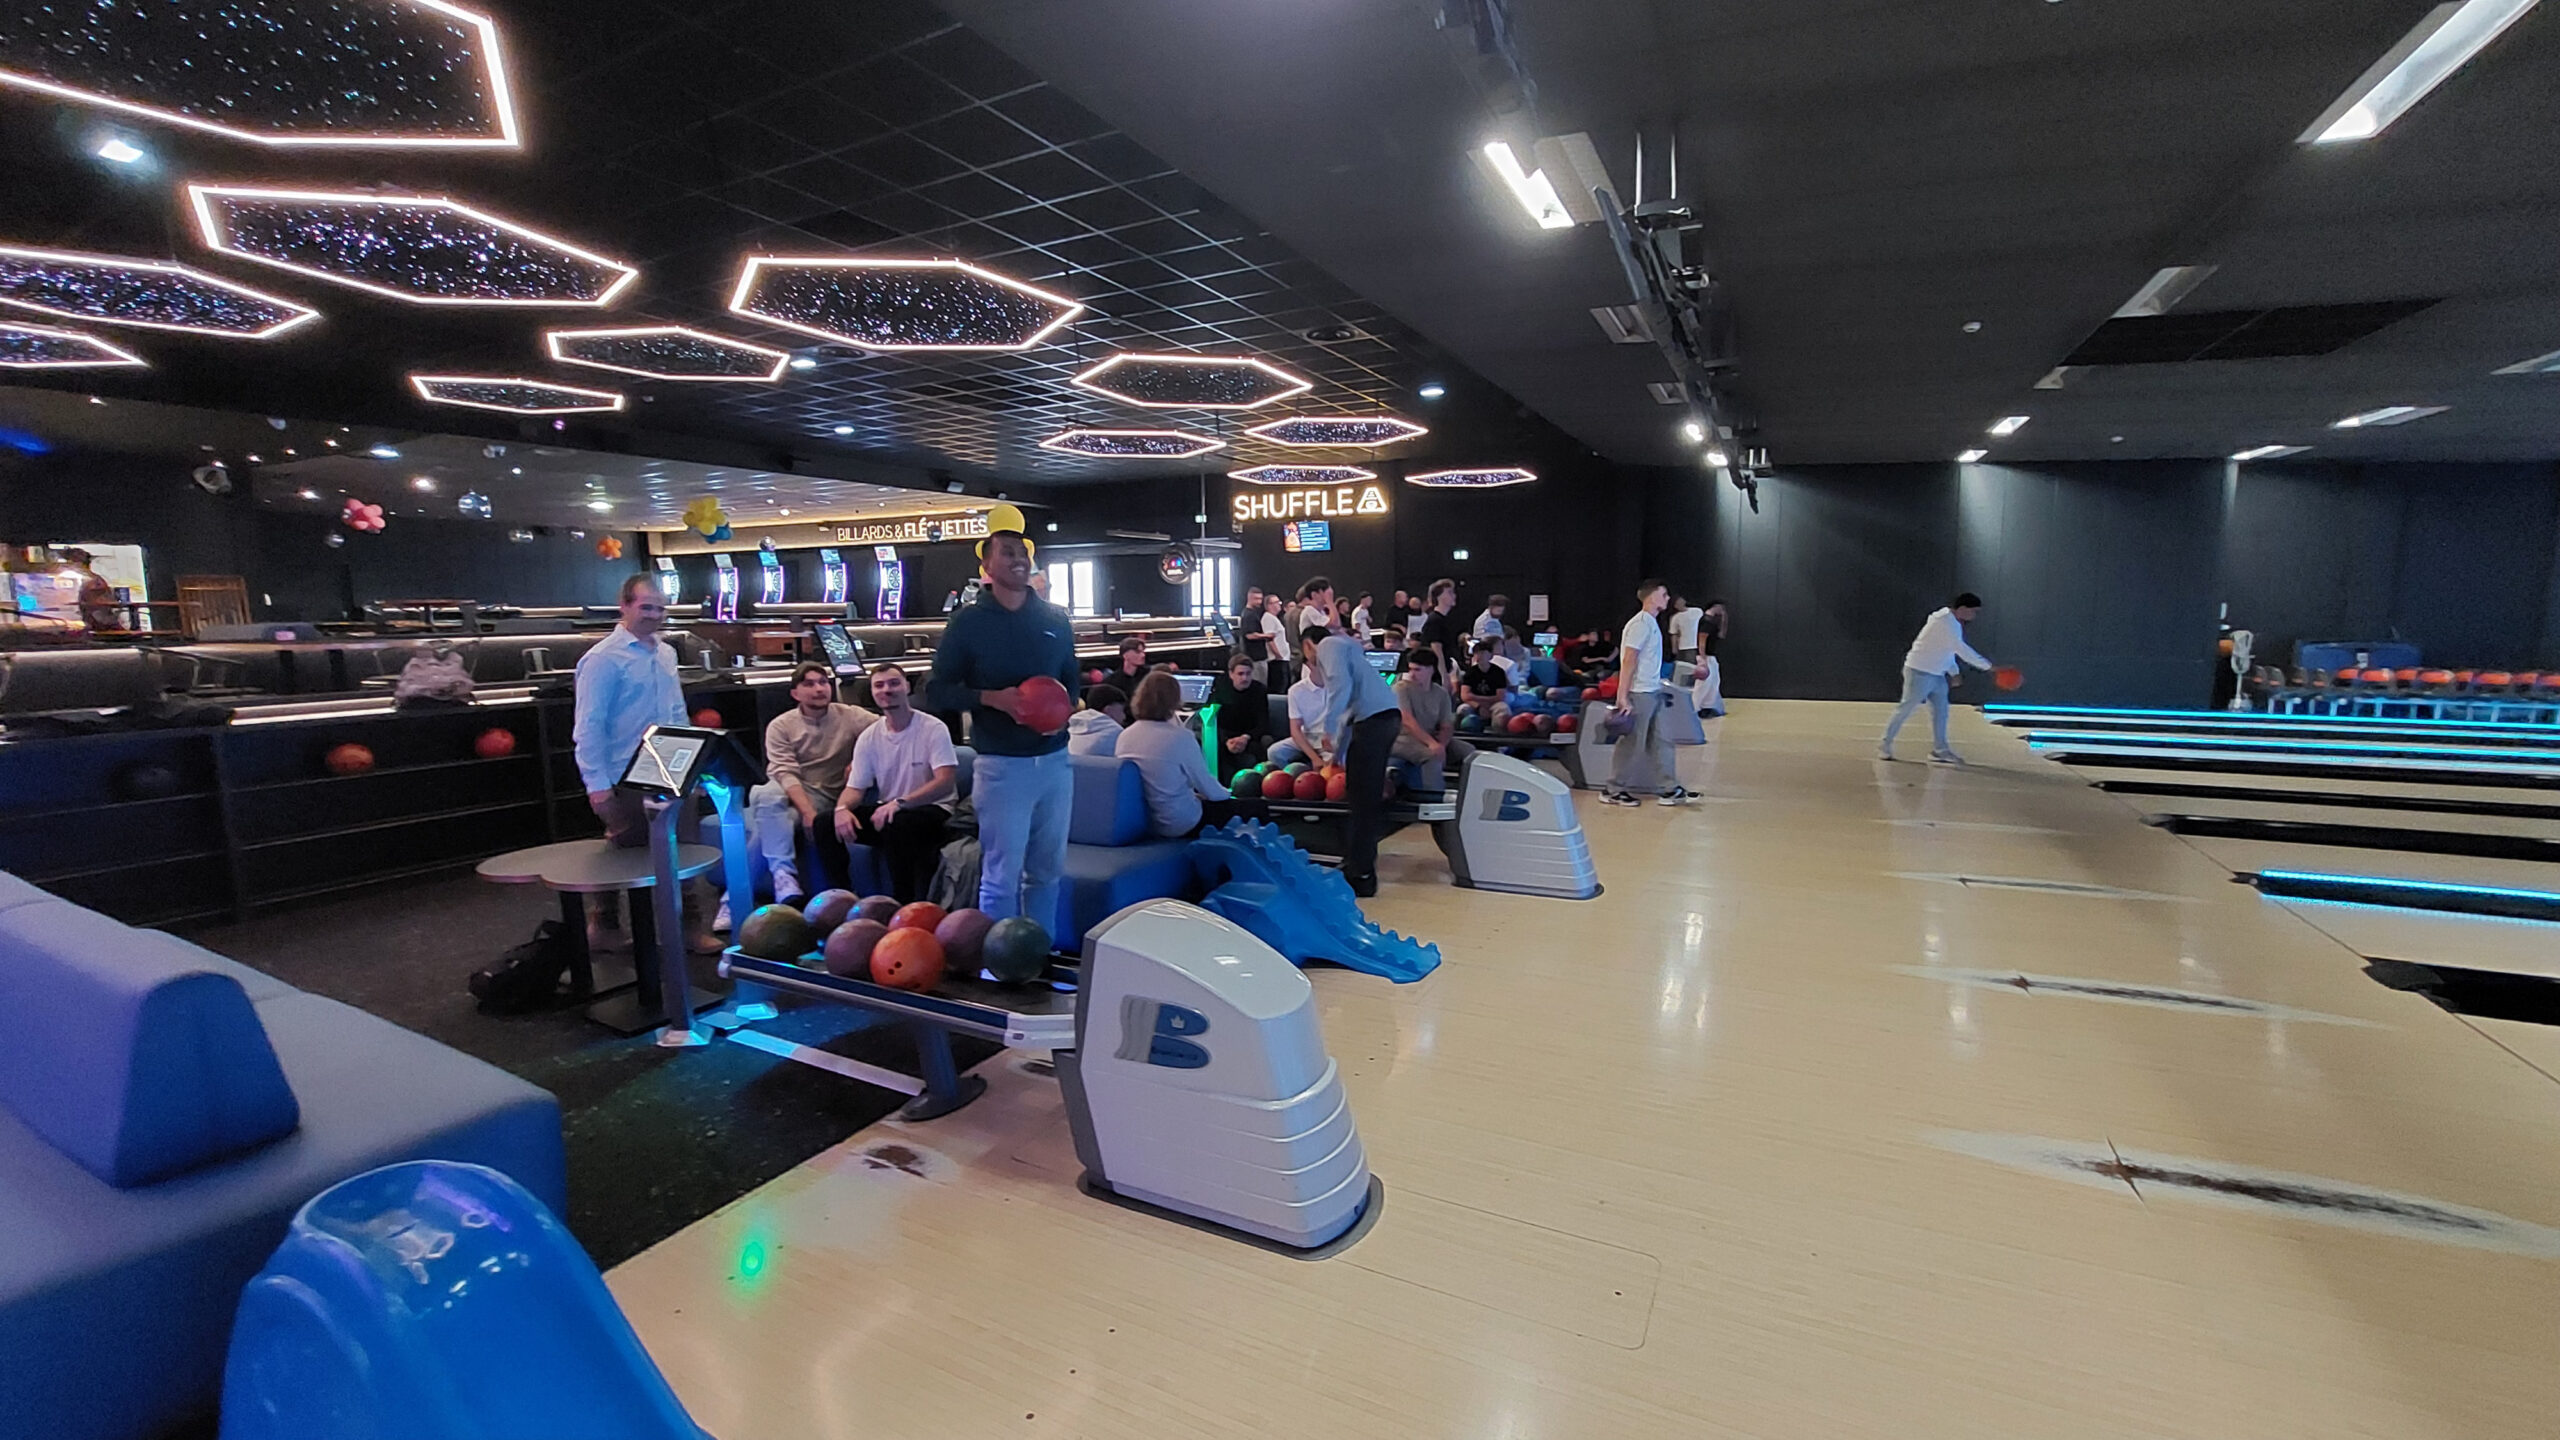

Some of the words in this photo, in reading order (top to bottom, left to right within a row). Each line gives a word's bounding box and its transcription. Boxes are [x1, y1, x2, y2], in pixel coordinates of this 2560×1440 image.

[1235, 489, 1354, 520] SHUFFLE
[837, 525, 894, 542] BILLARDS
[895, 524, 904, 539] &
[904, 517, 988, 538] FLÉHETTES
[1114, 995, 1210, 1069] B
